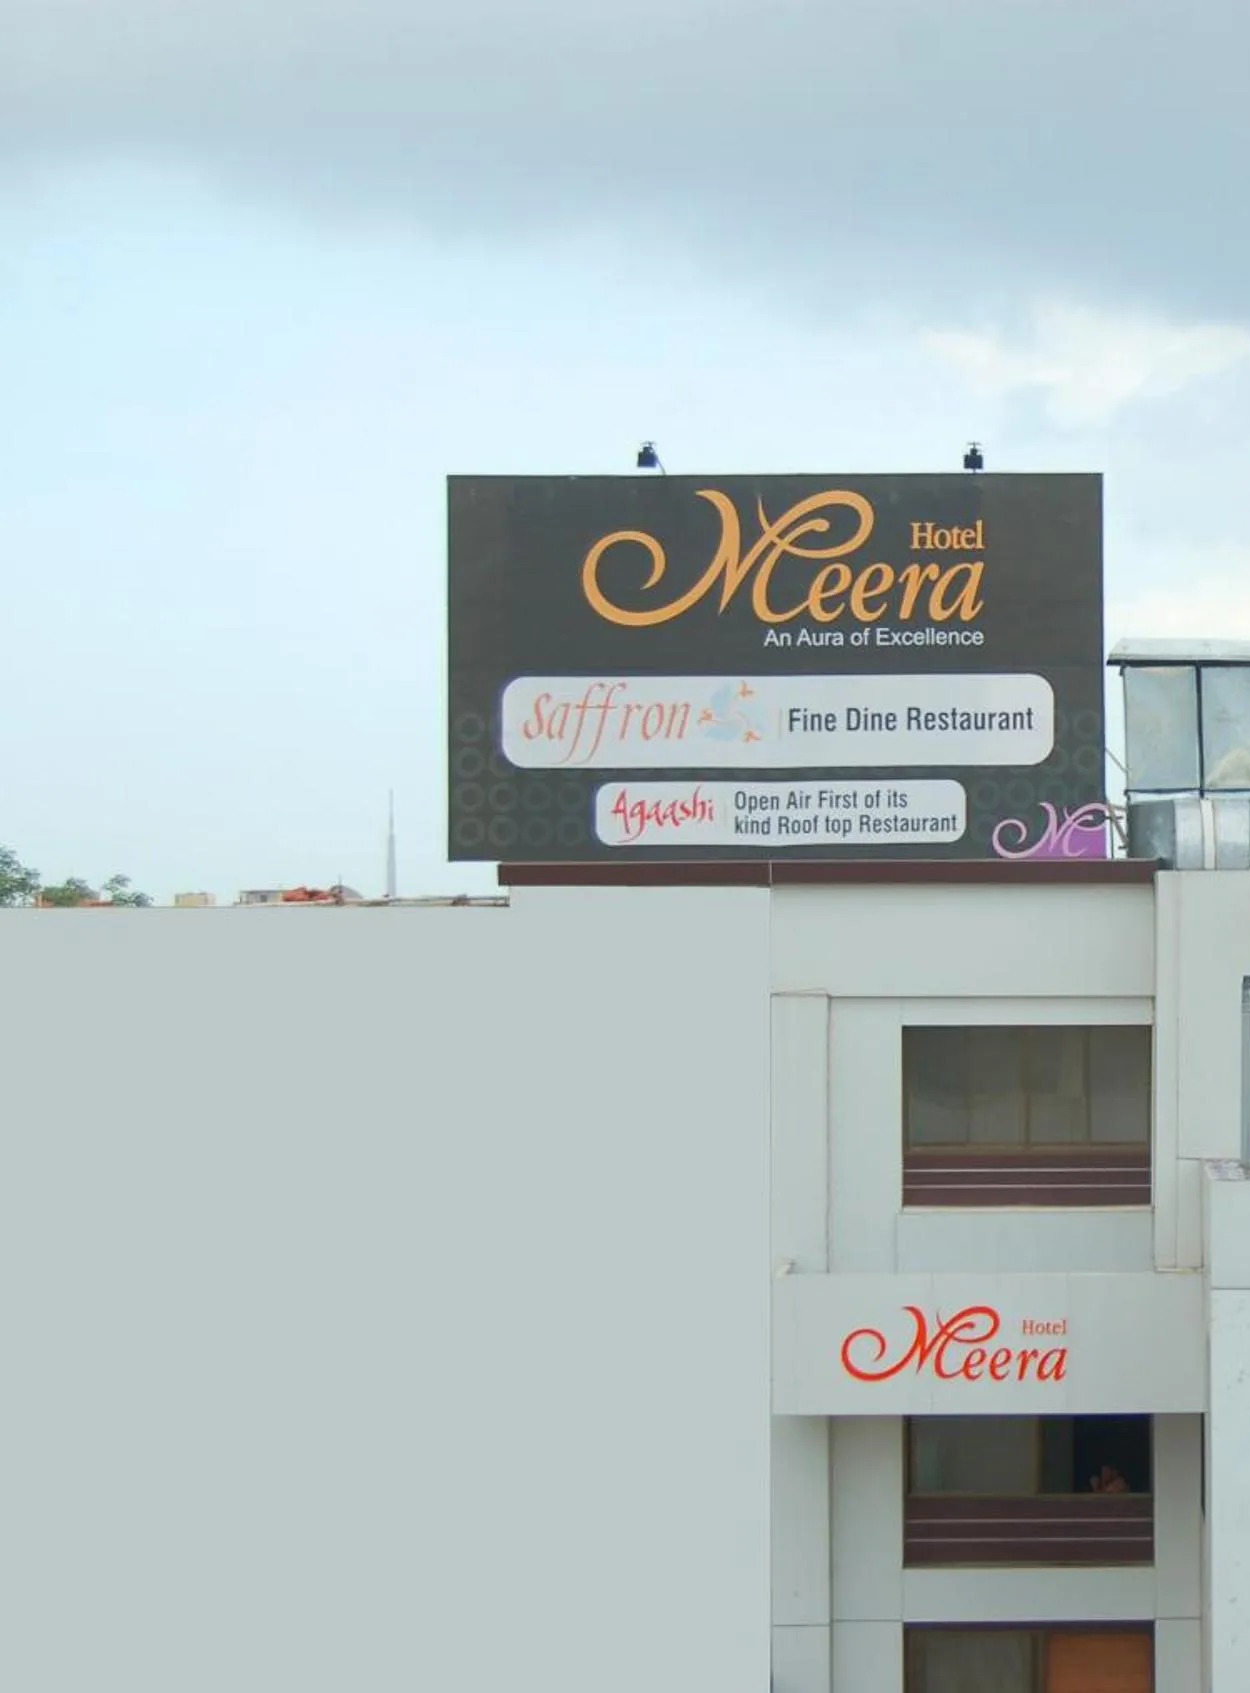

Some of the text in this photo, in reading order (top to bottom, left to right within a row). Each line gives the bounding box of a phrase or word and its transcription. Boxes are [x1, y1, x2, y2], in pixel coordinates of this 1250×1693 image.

[909, 521, 985, 551] Hotel
[582, 488, 985, 626] Meera
[763, 627, 985, 647] An Aura of Excellence
[522, 682, 692, 766] Saffron
[788, 706, 1034, 732] Fine Dine Restaurant
[611, 784, 714, 843] Agaashi
[734, 789, 908, 814] Open Air First of its
[734, 814, 957, 838] kind Roof top Restaurant
[1022, 1319, 1068, 1336] Hotel
[840, 1305, 1069, 1382] Meera
